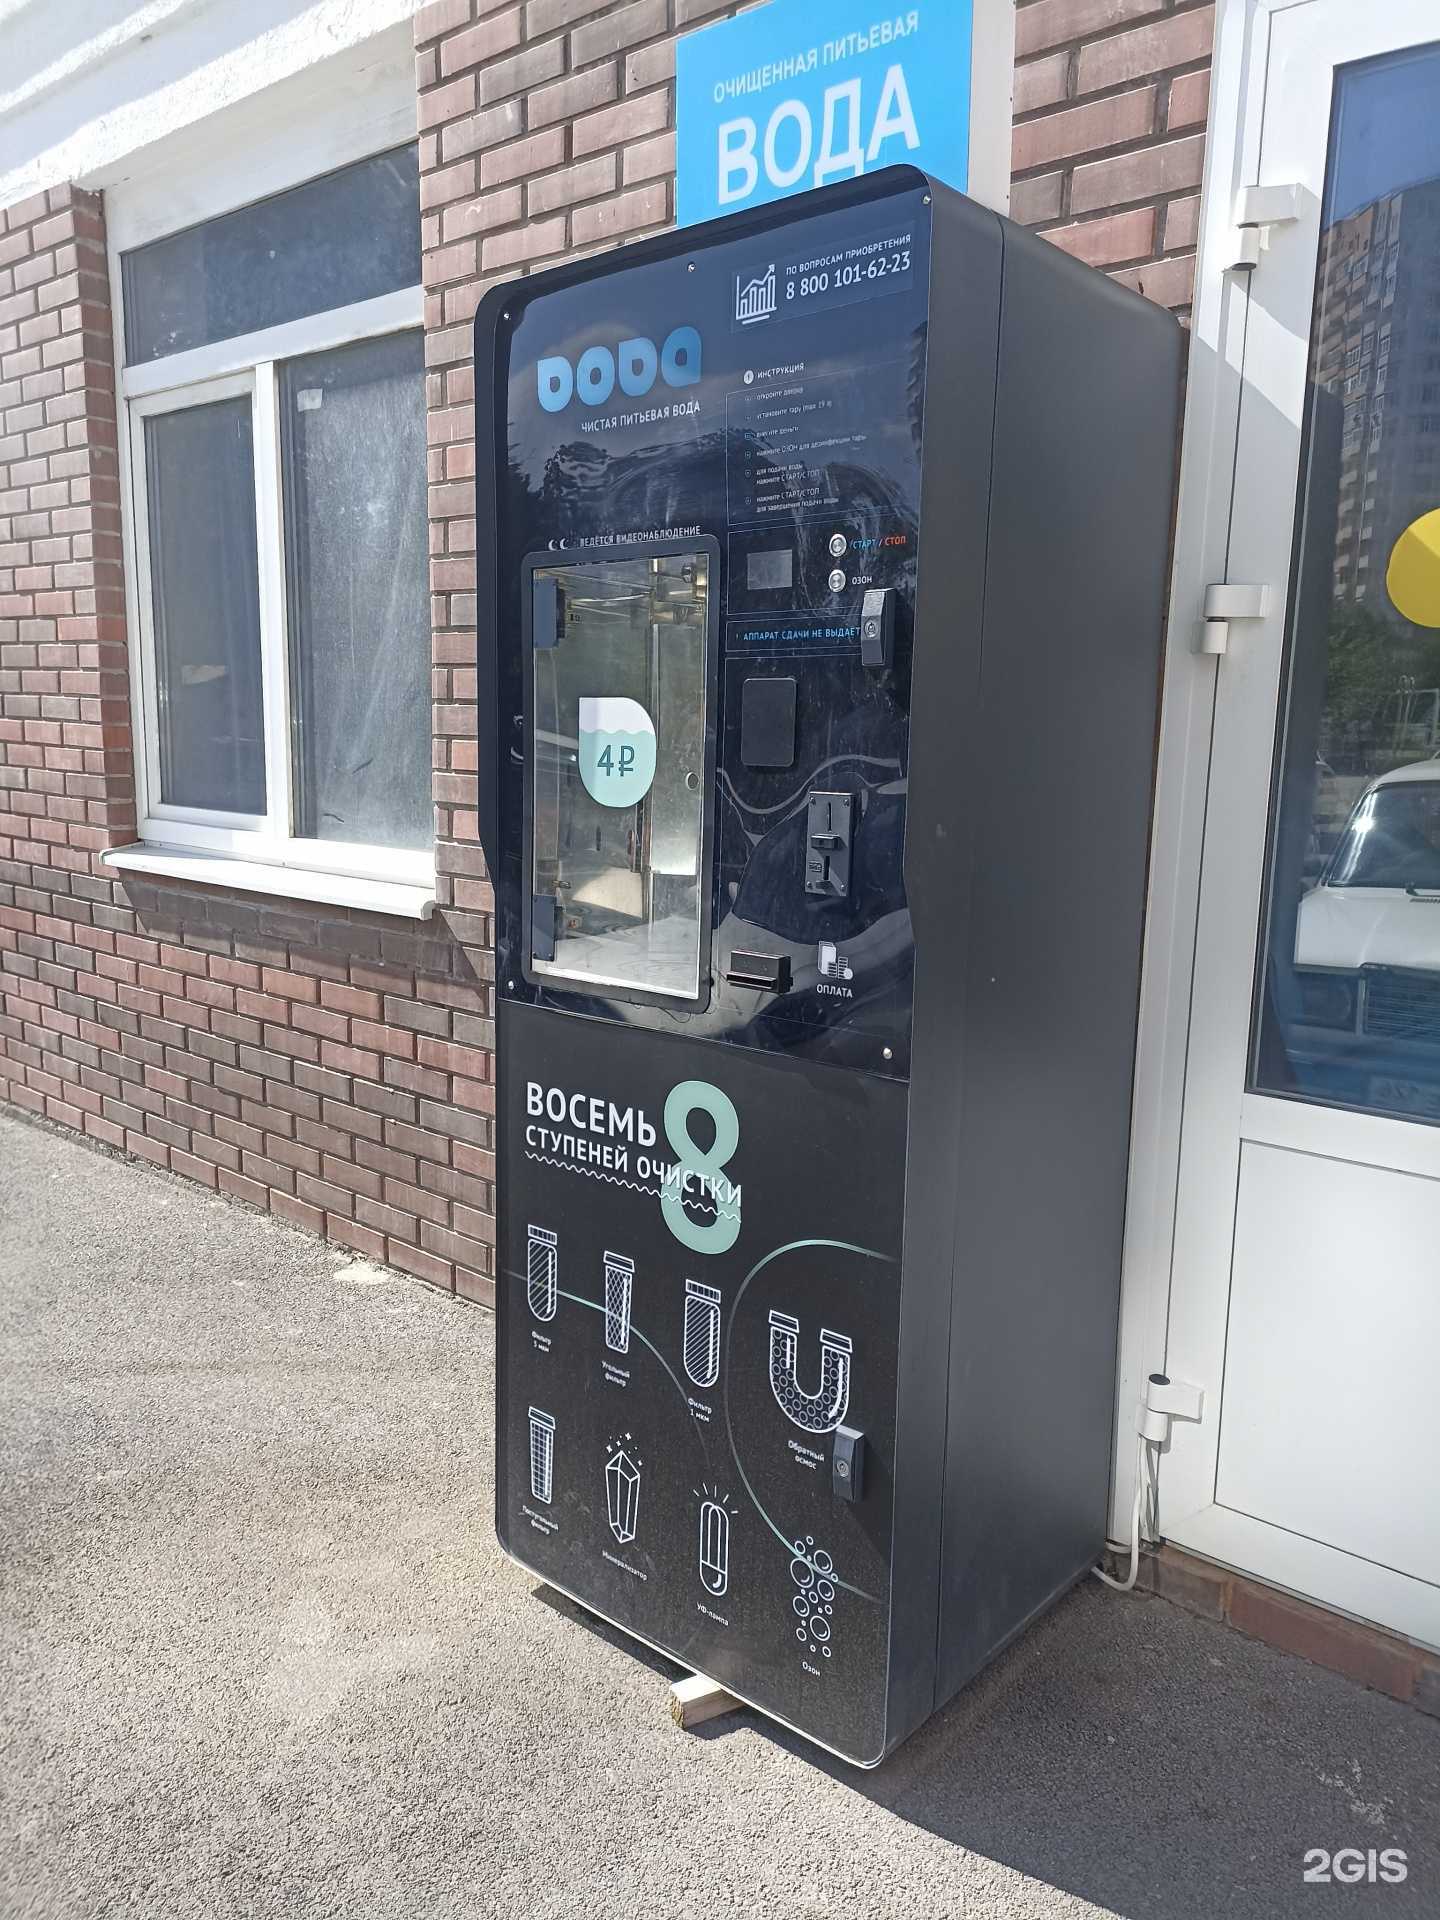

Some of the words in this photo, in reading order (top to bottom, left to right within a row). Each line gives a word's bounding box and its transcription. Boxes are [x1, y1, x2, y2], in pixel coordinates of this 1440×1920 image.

[714, 47, 818, 103] ОЧИЩЕННАЯ
[823, 10, 919, 65] ПИТЬЕВАЯ
[718, 64, 921, 206] ВОДА
[786, 266, 797, 276] ПО
[800, 253, 843, 273] ВОПРОСАМ
[845, 234, 911, 260] ПРИОБРЕТЕНИЯ
[786, 281, 795, 300] 8
[800, 273, 829, 297] 800
[834, 250, 911, 288] 101-62-23
[757, 362, 805, 379] ИНСТРУКЦИЯ
[581, 417, 617, 433] ЧИСТАЯ
[620, 404, 670, 425] ПИТЬЕВАЯ
[673, 400, 701, 417] ВОДА
[884, 535, 906, 546] СТОП
[851, 576, 873, 585] ОЗОН
[743, 631, 779, 641] АППАРАТ
[781, 630, 810, 641] СДАЧИ
[811, 630, 823, 638] НЕ
[816, 983, 853, 998] ОПЛАТА
[527, 1081, 657, 1147] ВОСЕМЬ
[525, 1125, 628, 1173] СТУПЕНЕЙ
[636, 1156, 742, 1208] ОЧИСТКИ
[661, 1080, 741, 1254] 8
[788, 1439, 825, 1462] Обратный
[696, 1601, 729, 1626] УФ-лампа
[802, 1660, 821, 1677] Озон
